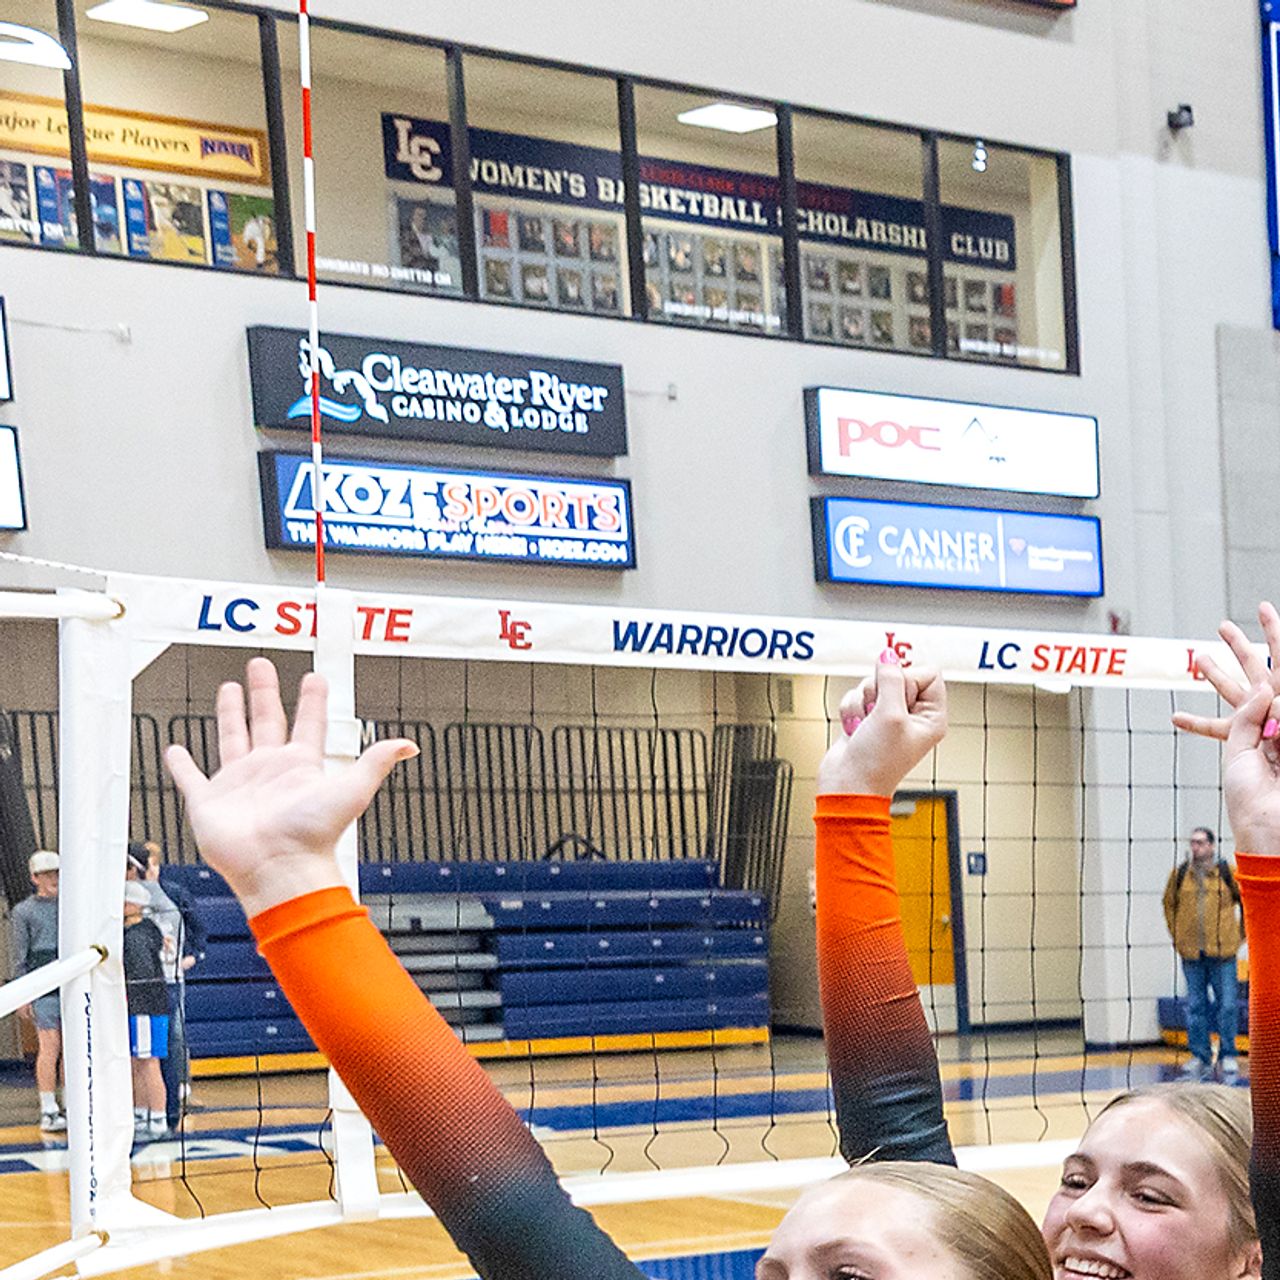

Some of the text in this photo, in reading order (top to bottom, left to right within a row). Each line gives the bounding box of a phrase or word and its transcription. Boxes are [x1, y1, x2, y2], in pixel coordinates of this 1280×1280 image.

[0, 111, 191, 151] ajor Legue Players
[394, 118, 442, 181] LC
[777, 205, 927, 250] CHOLARSHI
[951, 232, 1009, 262] CLUB
[362, 352, 608, 414] Clearwater River
[392, 399, 476, 424] CASINO
[511, 410, 588, 434] LODGE
[287, 522, 328, 544] TH
[329, 526, 426, 553] WARRIORS
[428, 531, 475, 555] PLAY
[878, 526, 996, 561] CANNER
[198, 595, 260, 632] LC
[274, 601, 413, 642] STTE
[612, 619, 815, 660] WARRIORS
[978, 641, 1022, 670] LC
[1031, 643, 1128, 676] STATE
